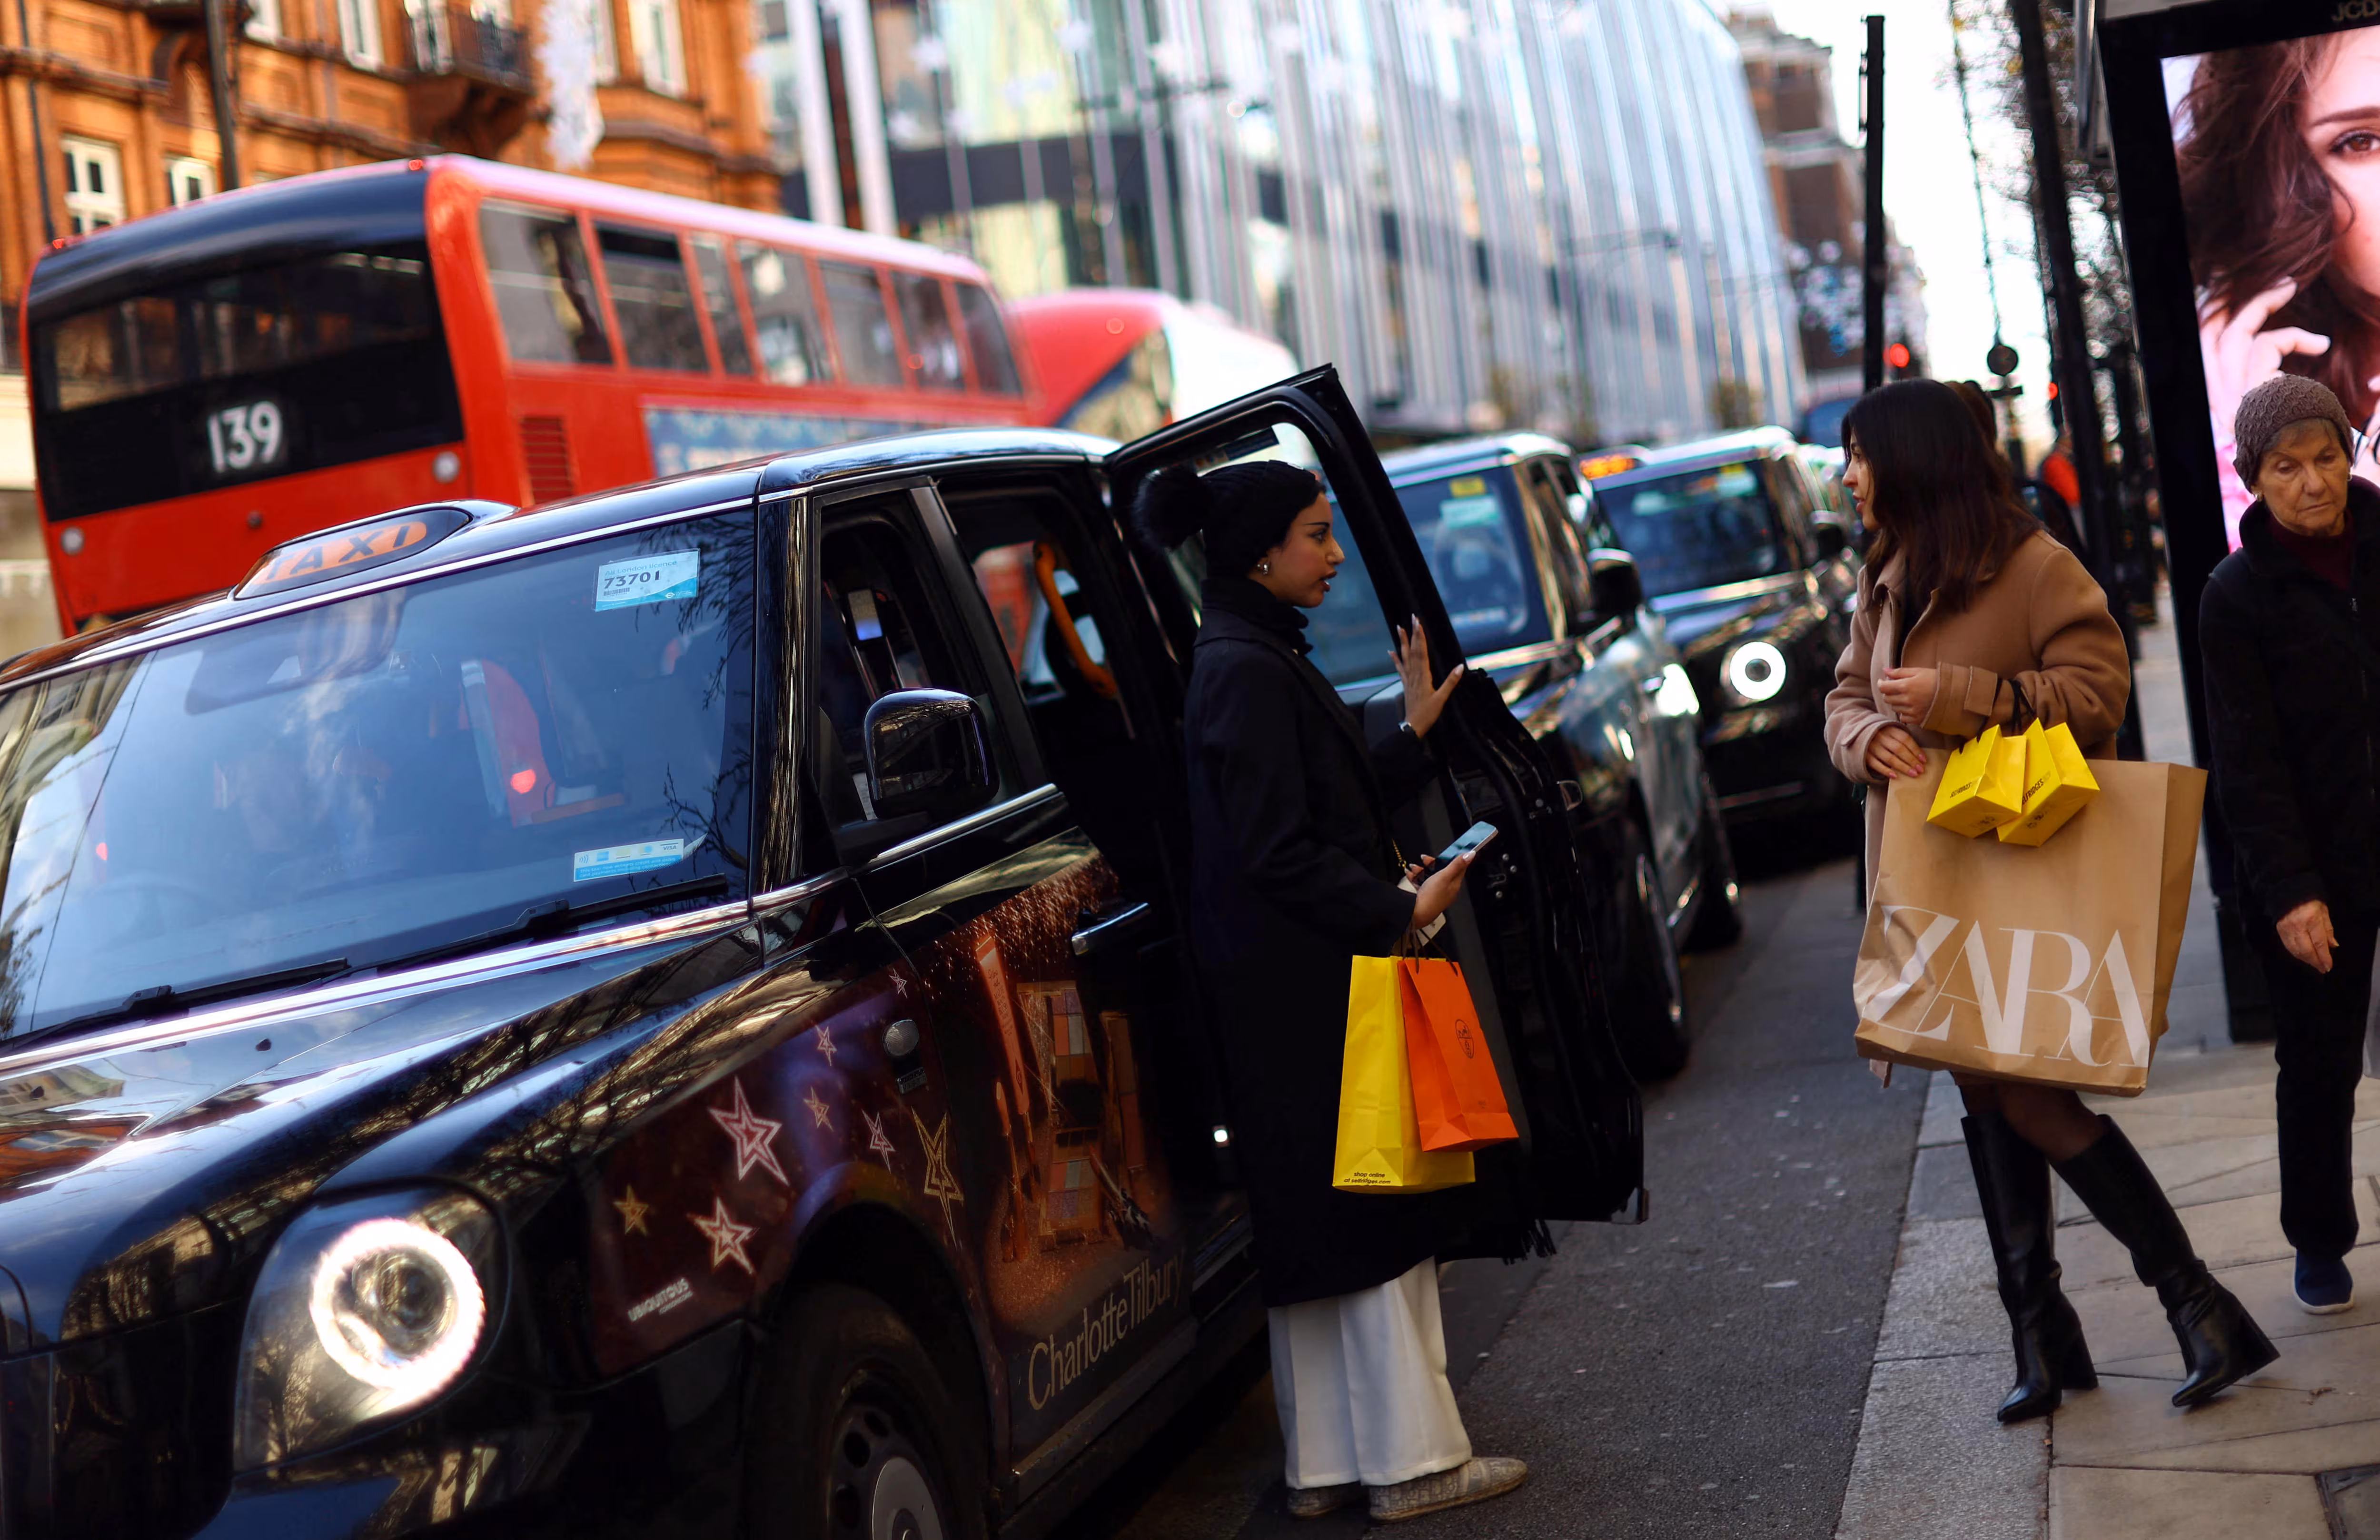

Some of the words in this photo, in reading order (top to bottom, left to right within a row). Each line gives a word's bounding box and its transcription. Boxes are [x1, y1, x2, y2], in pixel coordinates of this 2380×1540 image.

[2331, 0, 2380, 21] JCD
[207, 400, 282, 473] 139
[267, 525, 410, 580] TAXI
[649, 561, 677, 569] licence
[604, 570, 660, 589] 73701
[2022, 778, 2044, 805] ELFRIDGES
[1862, 905, 2151, 1068] ZARA
[1029, 1293, 1128, 1411] Charlotte
[1123, 1248, 1184, 1330] Tilbury
